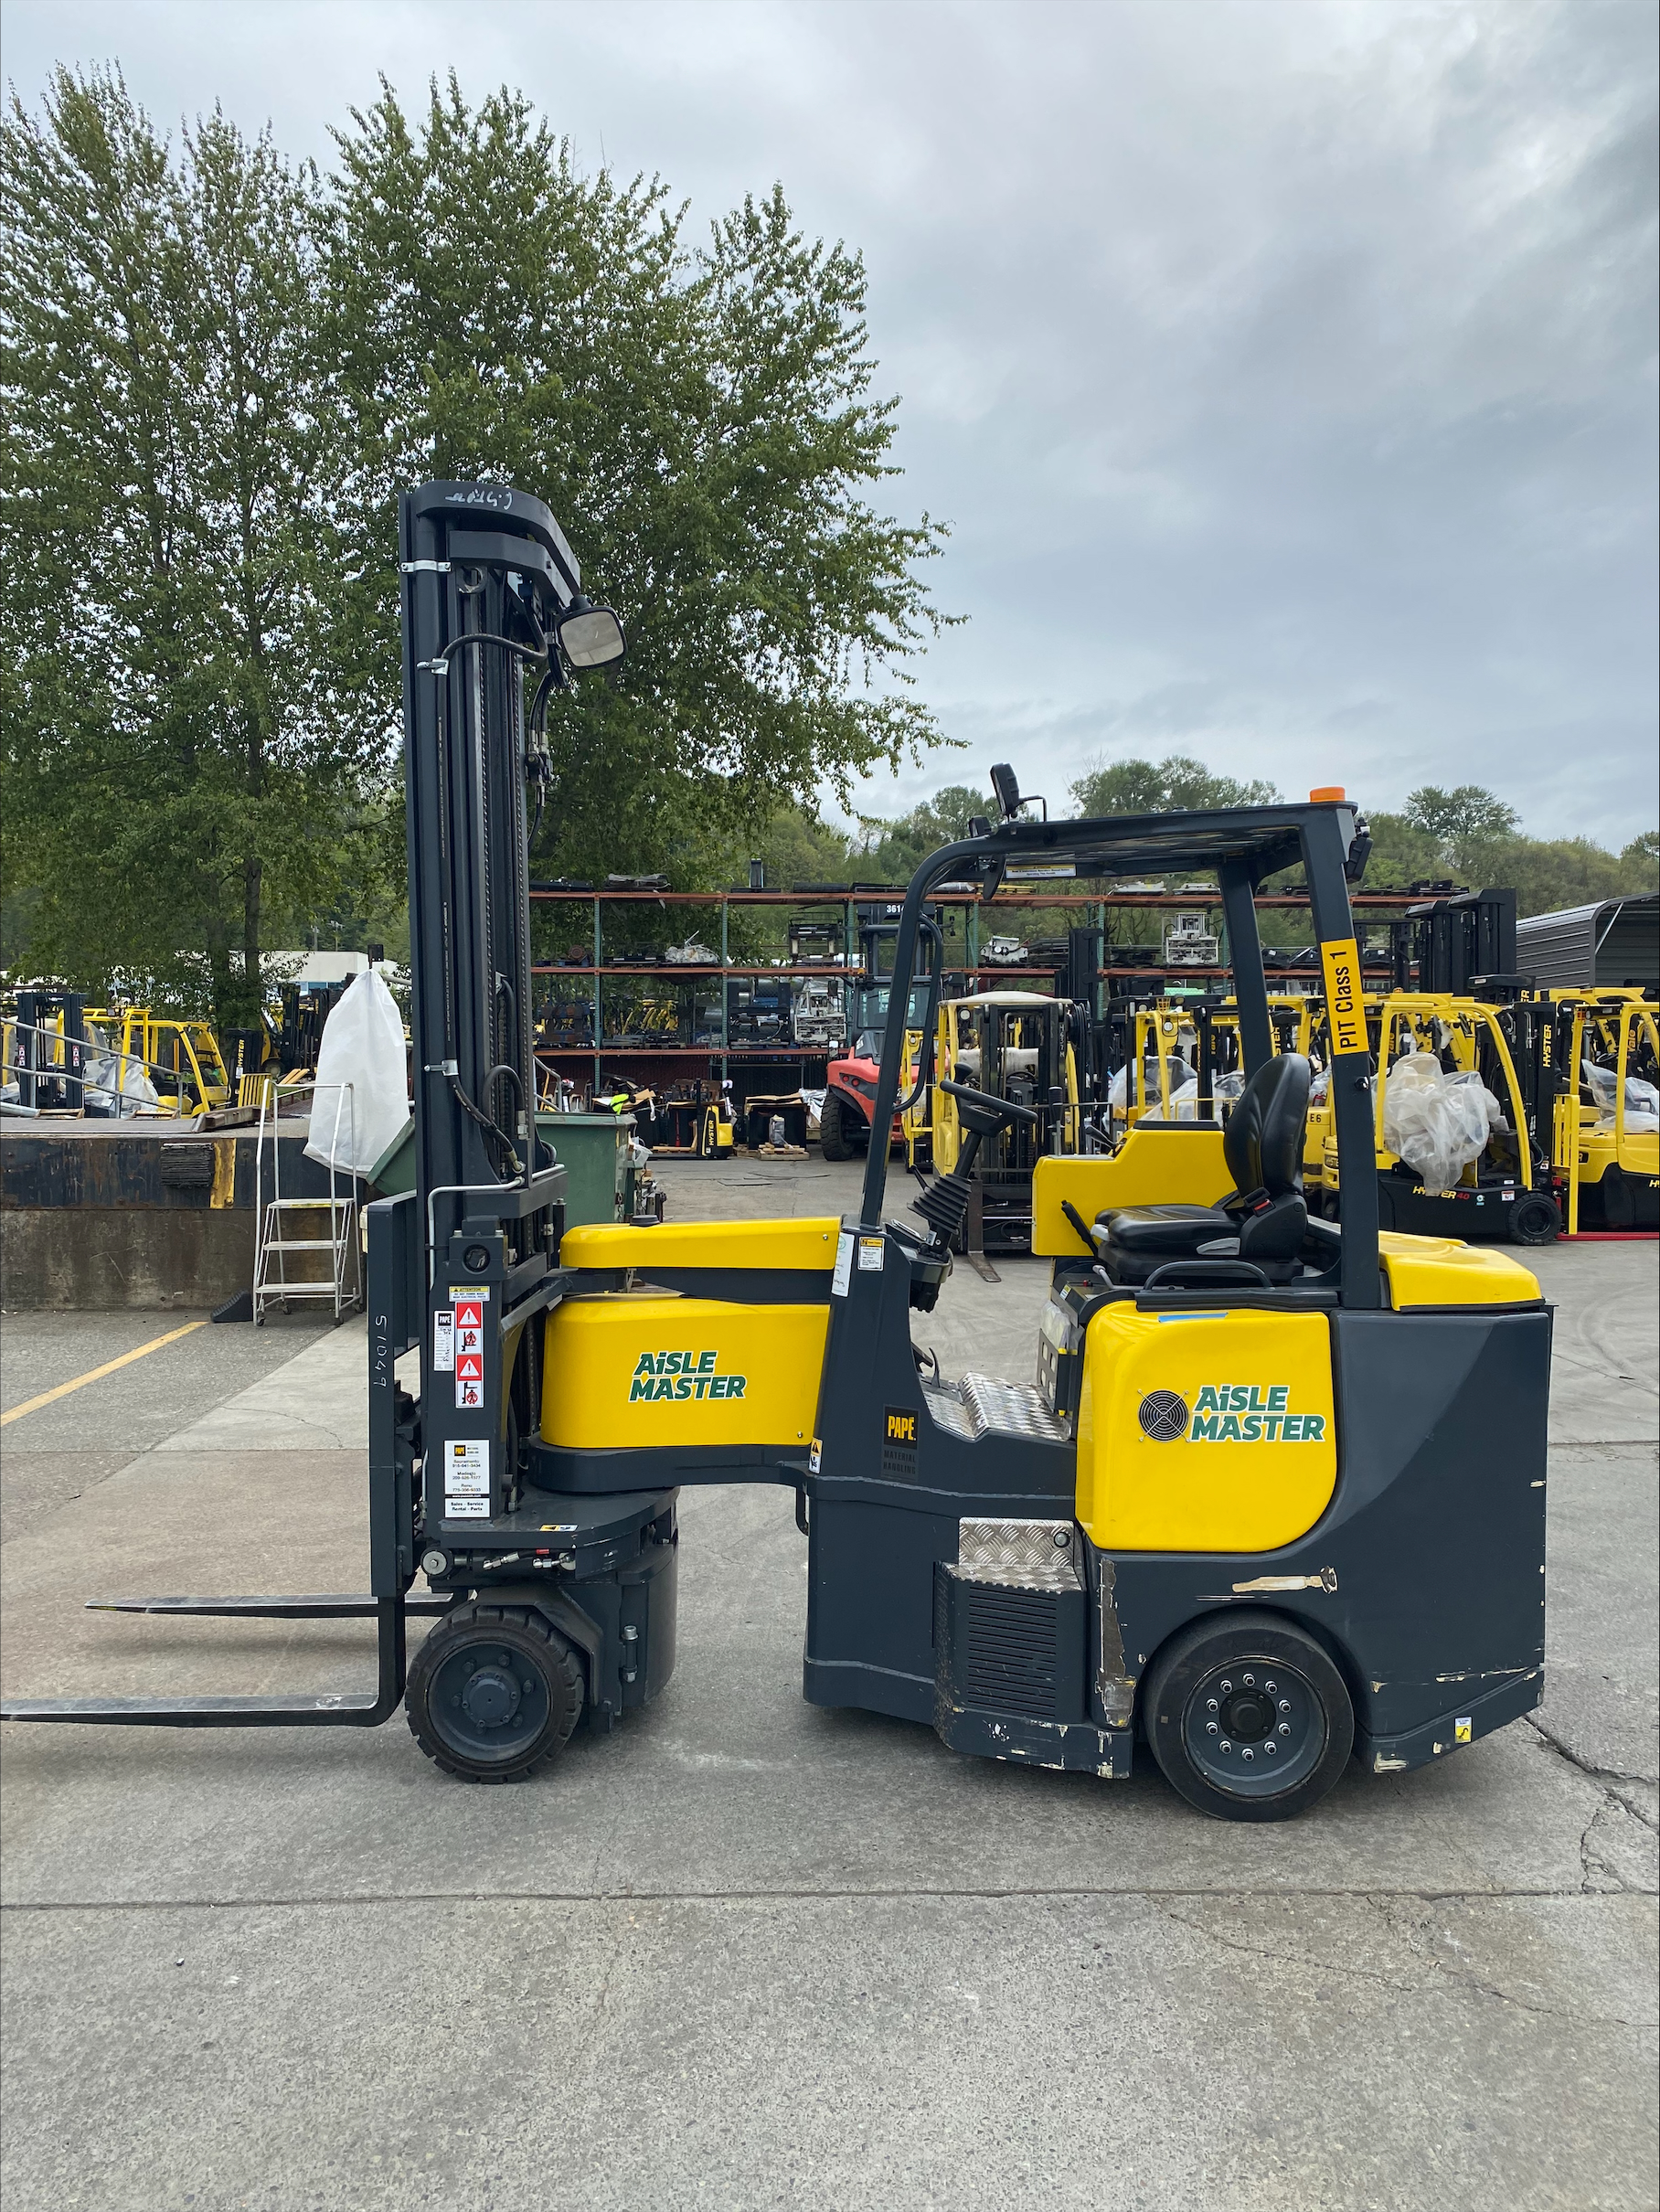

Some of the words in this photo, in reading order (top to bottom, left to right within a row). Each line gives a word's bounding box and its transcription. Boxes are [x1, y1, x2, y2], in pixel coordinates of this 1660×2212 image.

[1329, 951, 1347, 961] 1
[1335, 966, 1354, 1013] Class
[1337, 1020, 1358, 1049] PIT
[1543, 1024, 1552, 1068] HYSTER
[1411, 1186, 1457, 1200] HYER
[628, 1375, 747, 1402] MASTER
[1190, 1414, 1325, 1442] MASTER
[883, 1450, 916, 1462] MATERIAL
[883, 1462, 916, 1475] HANDLING
